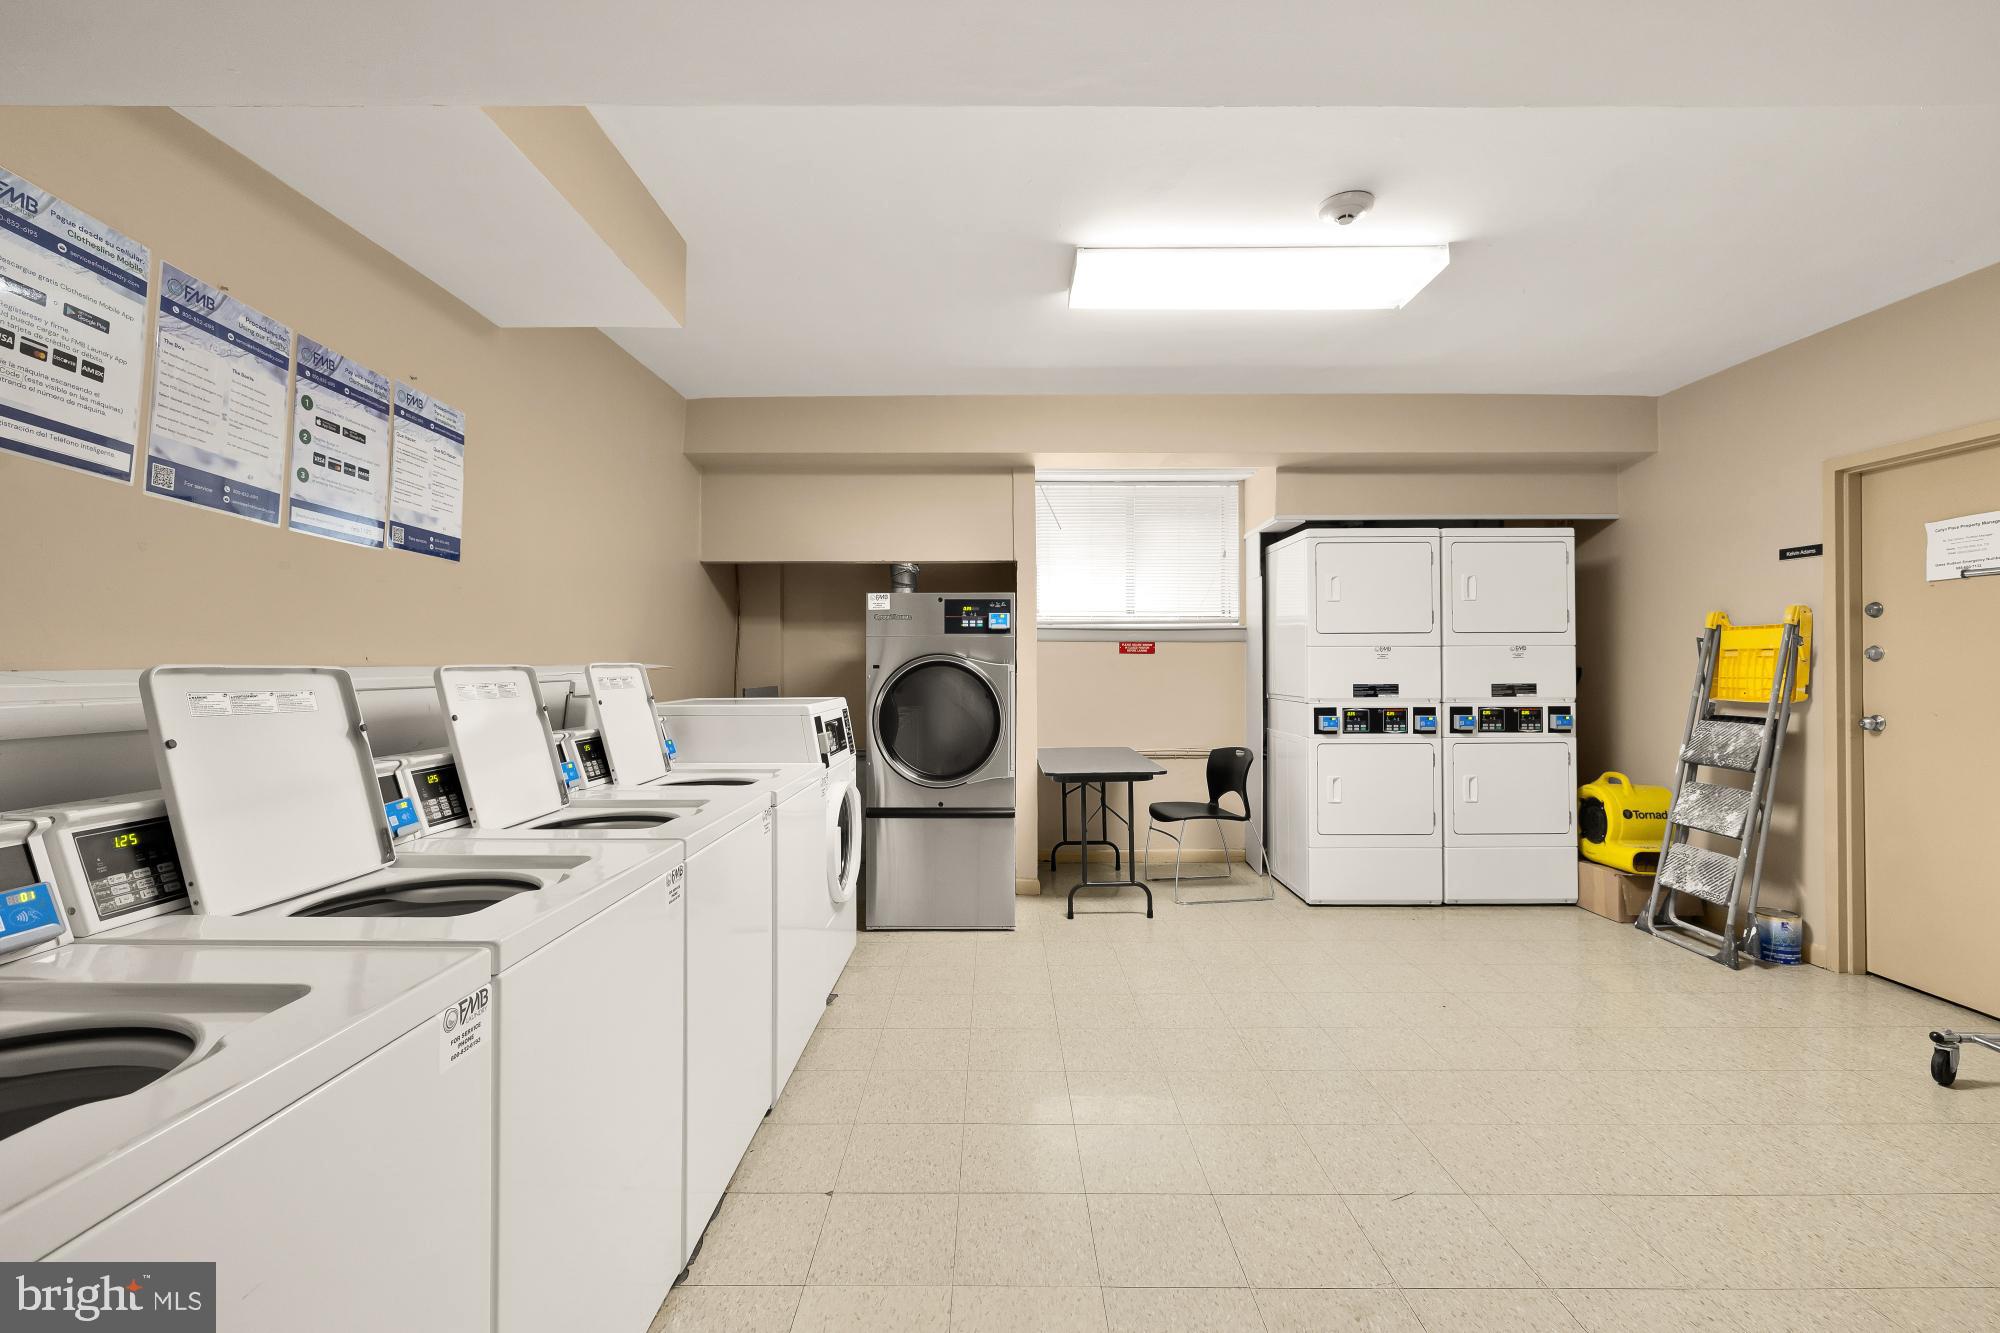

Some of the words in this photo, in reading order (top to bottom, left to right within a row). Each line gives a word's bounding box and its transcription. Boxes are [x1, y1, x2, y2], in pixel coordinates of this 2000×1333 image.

[50, 208, 77, 229] Pague
[78, 225, 104, 243] desde
[105, 239, 115, 249] su
[67, 229, 116, 260] Clothesline
[117, 254, 144, 275] Mobile
[38, 273, 59, 288] gratis
[60, 283, 98, 305] Clothesline
[99, 300, 121, 316] Mobile
[121, 310, 136, 323] App
[183, 284, 216, 311] FMB
[6, 320, 32, 337] tarjeta
[33, 331, 44, 341] de
[10, 314, 35, 328] puede
[87, 344, 114, 361] Laundry
[114, 356, 129, 367] App
[82, 364, 105, 379] AMEX
[312, 351, 336, 372] FMB
[45, 382, 69, 397] visible
[69, 389, 79, 398] en
[79, 393, 89, 402] las
[50, 376, 93, 397] escaneando
[406, 392, 424, 410] FMB
[36, 429, 48, 439] del
[302, 433, 309, 441] 2
[300, 471, 306, 480] 3
[1632, 810, 1668, 820] Tornad
[458, 987, 489, 1026] FMB
[450, 1035, 461, 1046] FOR
[461, 1021, 482, 1040] SERVICE
